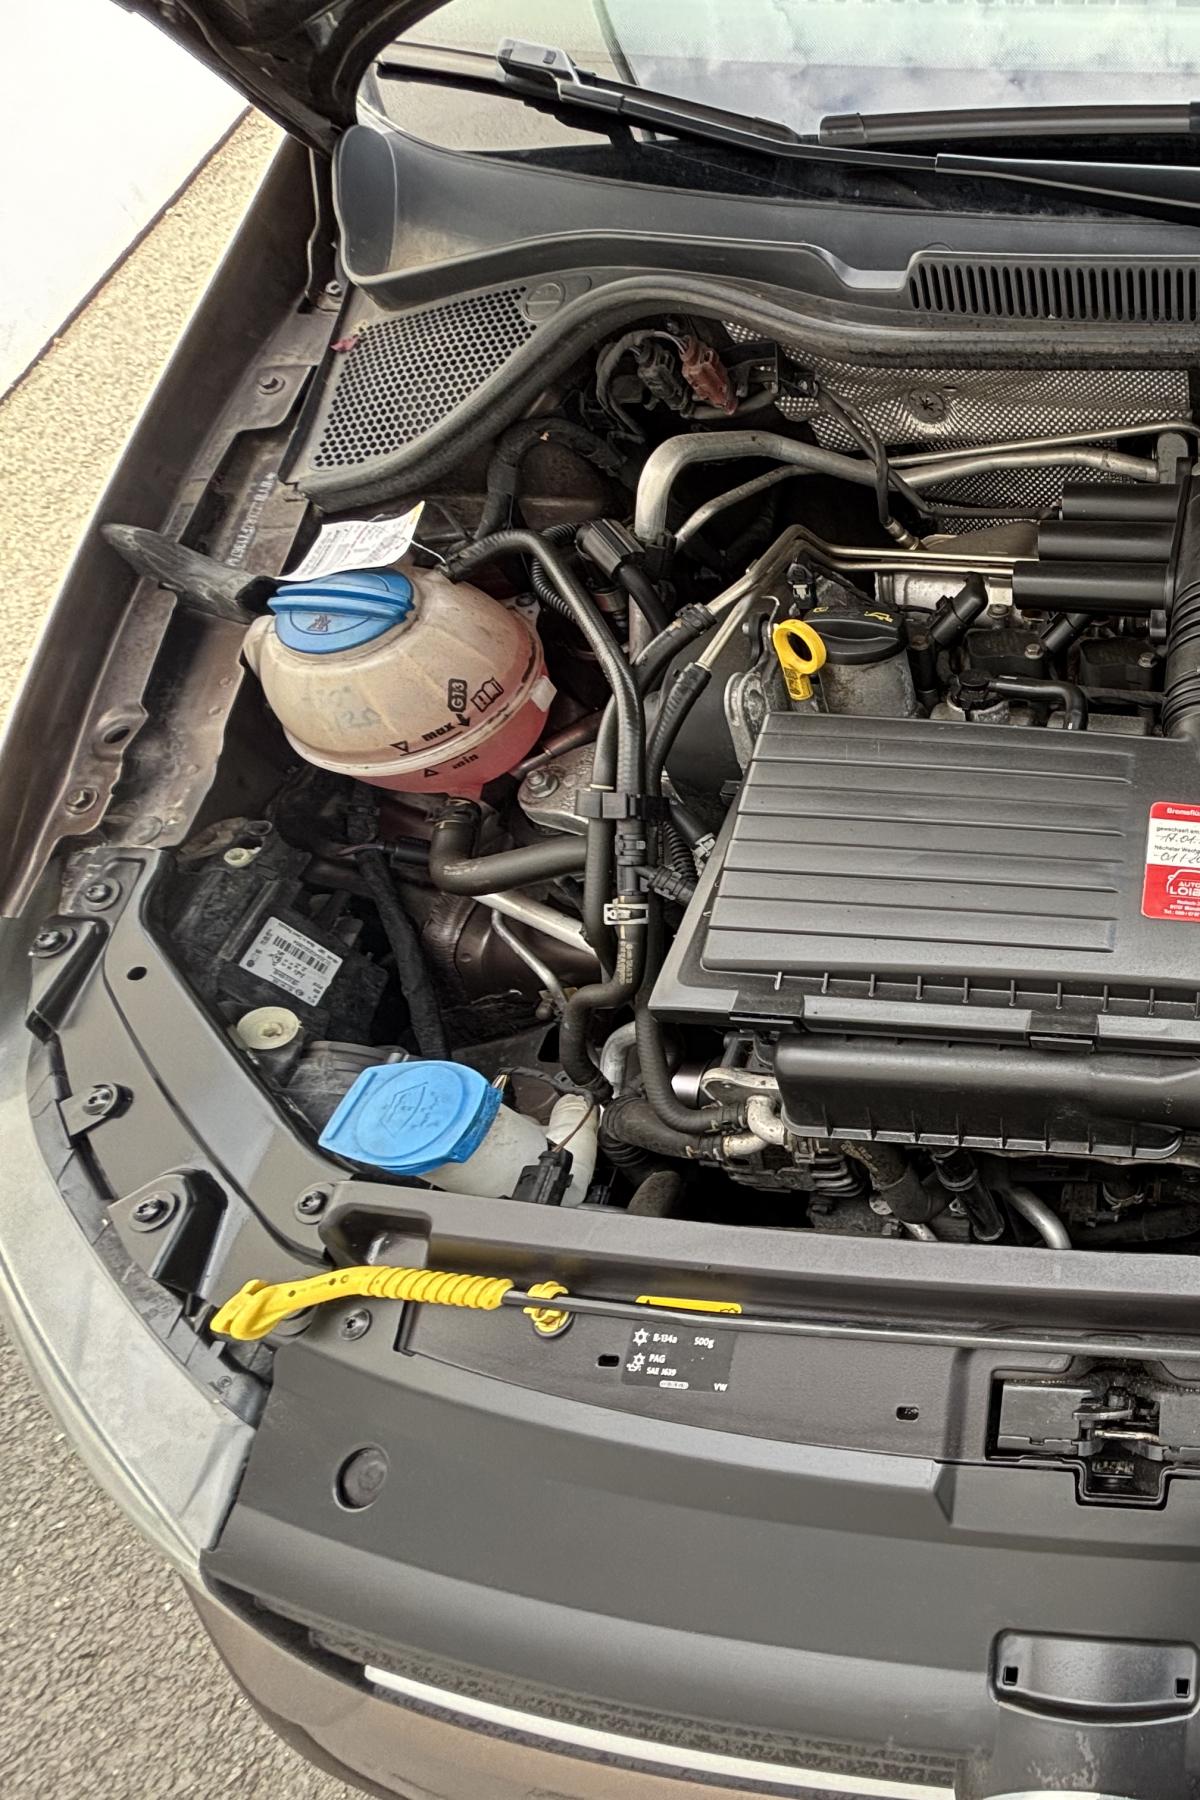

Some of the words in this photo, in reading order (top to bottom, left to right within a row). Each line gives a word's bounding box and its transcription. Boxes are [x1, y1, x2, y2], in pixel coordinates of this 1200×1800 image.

[451, 682, 465, 709] G13
[421, 722, 456, 742] max
[452, 754, 479, 769] min
[694, 1336, 715, 1349] 500g
[648, 1354, 666, 1364] PAG
[646, 1367, 659, 1376] SAE
[661, 1367, 677, 1377] J639
[713, 1383, 728, 1392] VW
